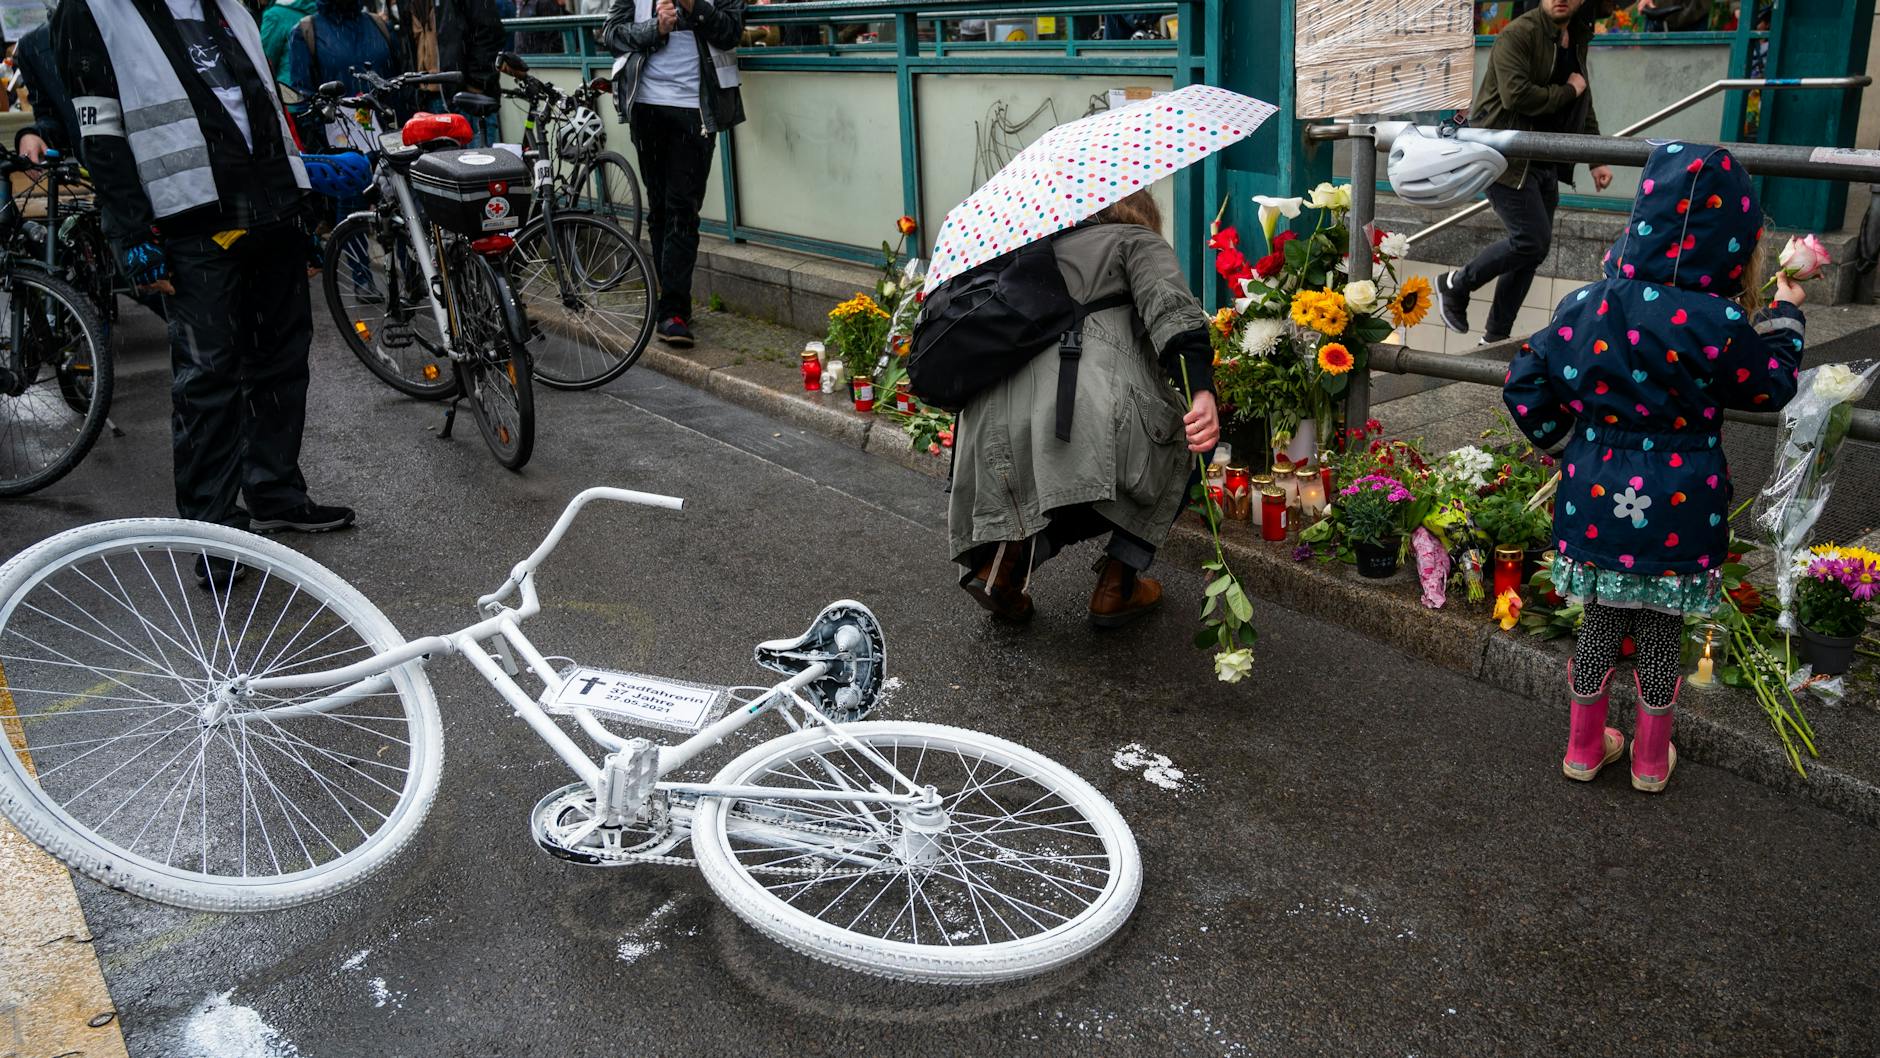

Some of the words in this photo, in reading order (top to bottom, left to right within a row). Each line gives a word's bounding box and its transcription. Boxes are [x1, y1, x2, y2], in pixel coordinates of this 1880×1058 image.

[77, 105, 97, 126] ER
[610, 687, 629, 696] 37
[632, 693, 675, 707] Jahre
[616, 681, 703, 703] Radfahrerin
[605, 694, 670, 712] 27.05.2021
